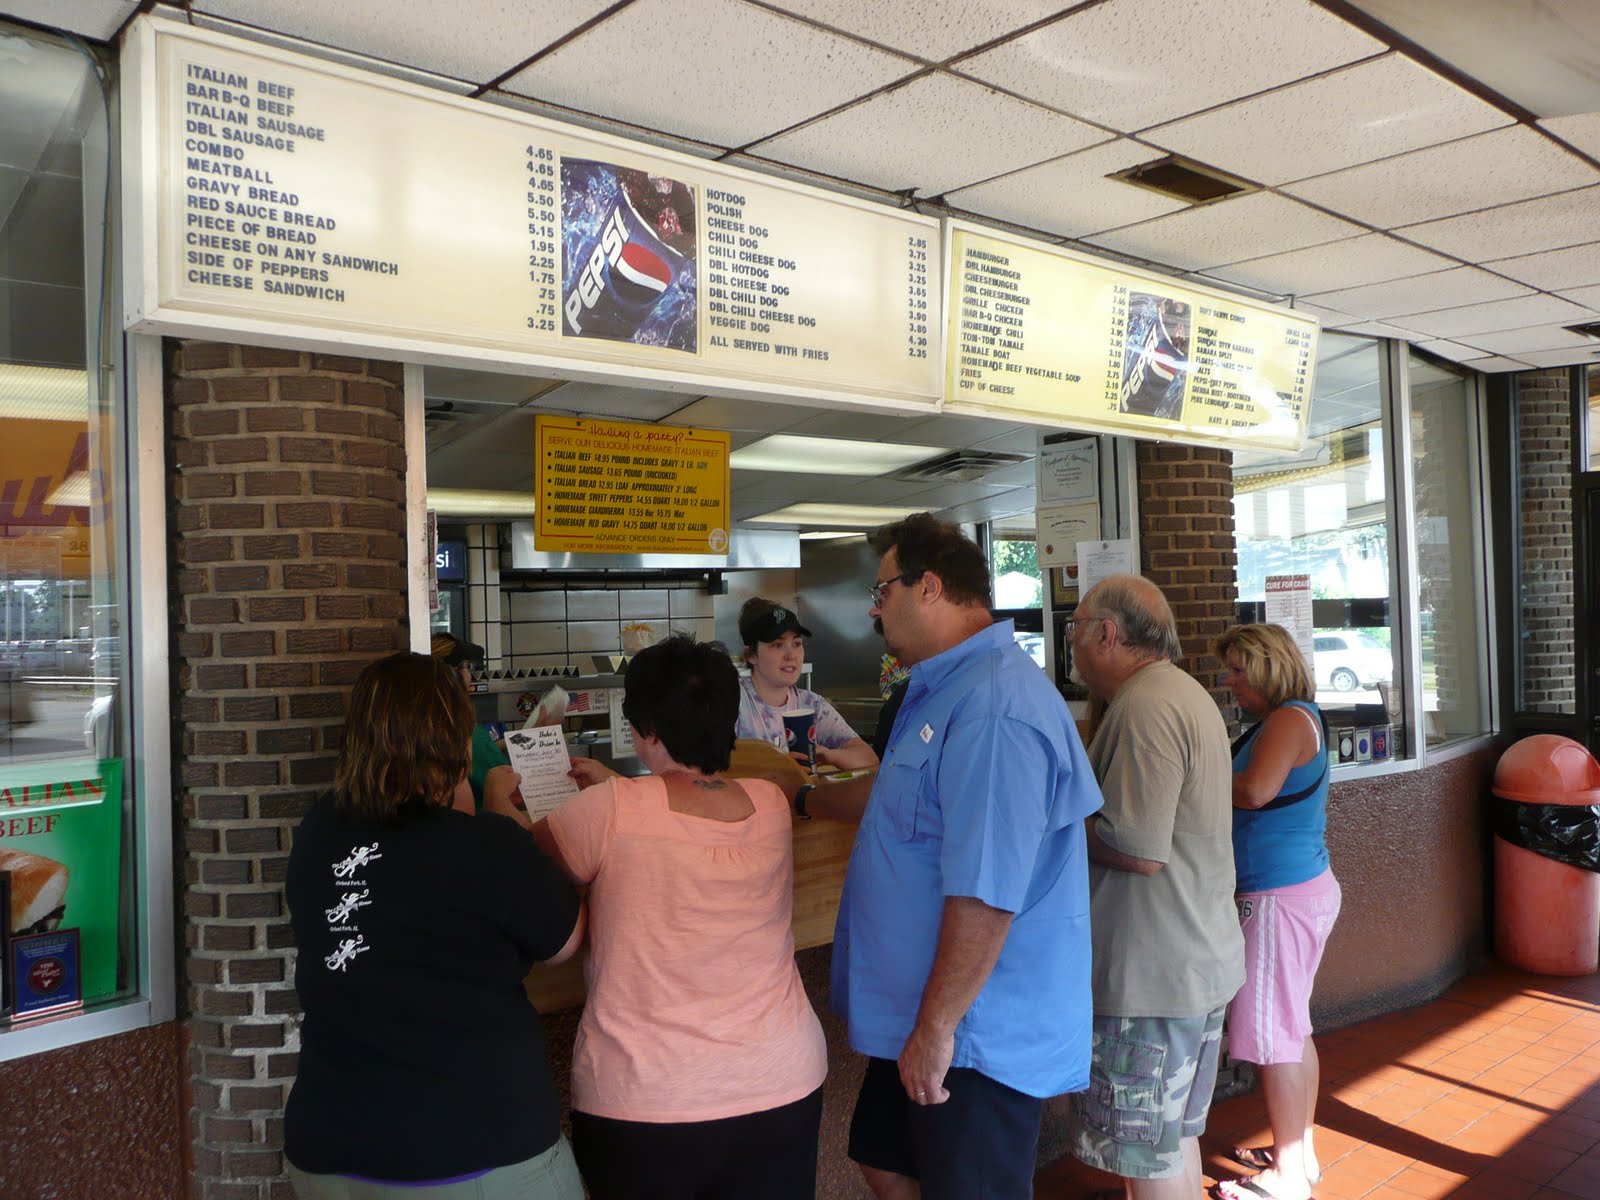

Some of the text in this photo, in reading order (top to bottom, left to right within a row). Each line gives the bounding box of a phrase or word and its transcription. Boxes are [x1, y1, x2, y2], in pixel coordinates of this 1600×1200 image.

[187, 64, 295, 99] ITALIAN BEEF
[257, 99, 294, 117] BEEF
[187, 102, 325, 141] ITALIAN SAUSAGE
[186, 120, 295, 153] DBL SAUSAGE
[186, 139, 244, 160] COMBO
[526, 145, 553, 161] 4.65
[187, 158, 273, 184] MEATBALL
[526, 161, 554, 176] 4.65
[187, 176, 299, 207] GRAVY BREAD
[529, 177, 554, 191] 4.65
[527, 192, 554, 207] 5.50
[707, 189, 746, 207] HOTDOG
[188, 195, 336, 230] RED SAUCE BREAD
[528, 208, 555, 222] 5.50
[707, 203, 742, 219] POLISH
[188, 213, 316, 245] PIECE OF BREAD
[529, 225, 554, 238] 5.15
[708, 218, 768, 238] CHEESE DOG
[531, 240, 555, 253] 1.95
[708, 232, 758, 250] CHILI DOG
[187, 232, 399, 275] CHEESE ON ANY SANDWICH
[529, 256, 555, 269] 2.25
[709, 245, 796, 271] CHILI CHEESE DOG
[188, 251, 329, 282] SIDE OF PEPPERS
[564, 206, 630, 335] PEPSI
[709, 259, 769, 279] DBL HOTDOG
[188, 270, 345, 302] CHEESE SANDWICH
[529, 272, 555, 285] 1.75
[710, 273, 790, 296] DBL CHEESE DOG
[539, 288, 555, 300] .75
[710, 288, 778, 308] DBL CHILI DOG
[536, 303, 555, 316] .75
[710, 302, 816, 327] DBL CHILI CHEESE DOG
[527, 317, 555, 331] 3.25
[710, 316, 770, 333] VEGGIE DOG
[710, 336, 829, 361] ALL SERVED WITH FRIES
[962, 344, 1010, 359] TAMALE BOAT
[999, 339, 1024, 350] TAMALE
[961, 368, 982, 378] FRIES
[962, 356, 1002, 371] HOMEMADE
[1006, 363, 1022, 373] BEEF
[1026, 366, 1062, 380] VEGETABLE
[960, 380, 975, 389] CUP
[990, 384, 1015, 395] CHEESE
[548, 436, 573, 445] SERVE
[594, 441, 630, 450] DELICIOUS
[633, 444, 672, 454] HOMEMADE
[646, 432, 684, 445] party?
[554, 450, 576, 460] ITALIAN
[578, 453, 591, 461] BEEF
[612, 456, 630, 464] POUND
[633, 458, 658, 466] INCLUDES
[661, 460, 678, 468] GRAVY
[554, 464, 576, 473] ITALIAN
[579, 466, 603, 475] SAUSAGE
[554, 478, 576, 486] ITALIAN
[579, 479, 596, 488] BREAD
[554, 491, 586, 501] HOMEMADE
[589, 493, 607, 502] SWEET
[610, 494, 633, 503] PEPPERS
[554, 518, 586, 527] HOMEMADE
[602, 520, 620, 528] GRAVY
